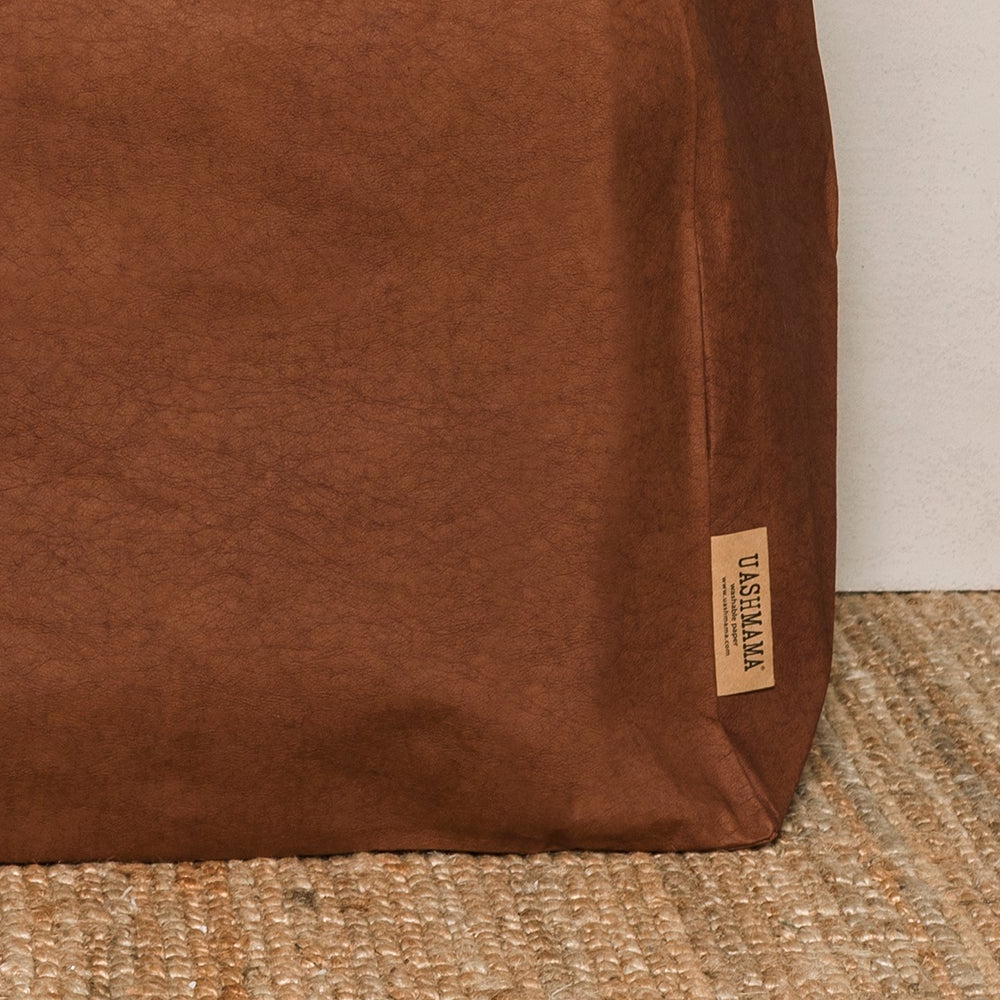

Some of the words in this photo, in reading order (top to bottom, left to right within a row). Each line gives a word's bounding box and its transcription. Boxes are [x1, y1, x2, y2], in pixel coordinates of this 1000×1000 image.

[722, 576, 730, 656] www.uashmama.com
[730, 583, 738, 621] washable
[738, 553, 764, 671] UASHMAMA
